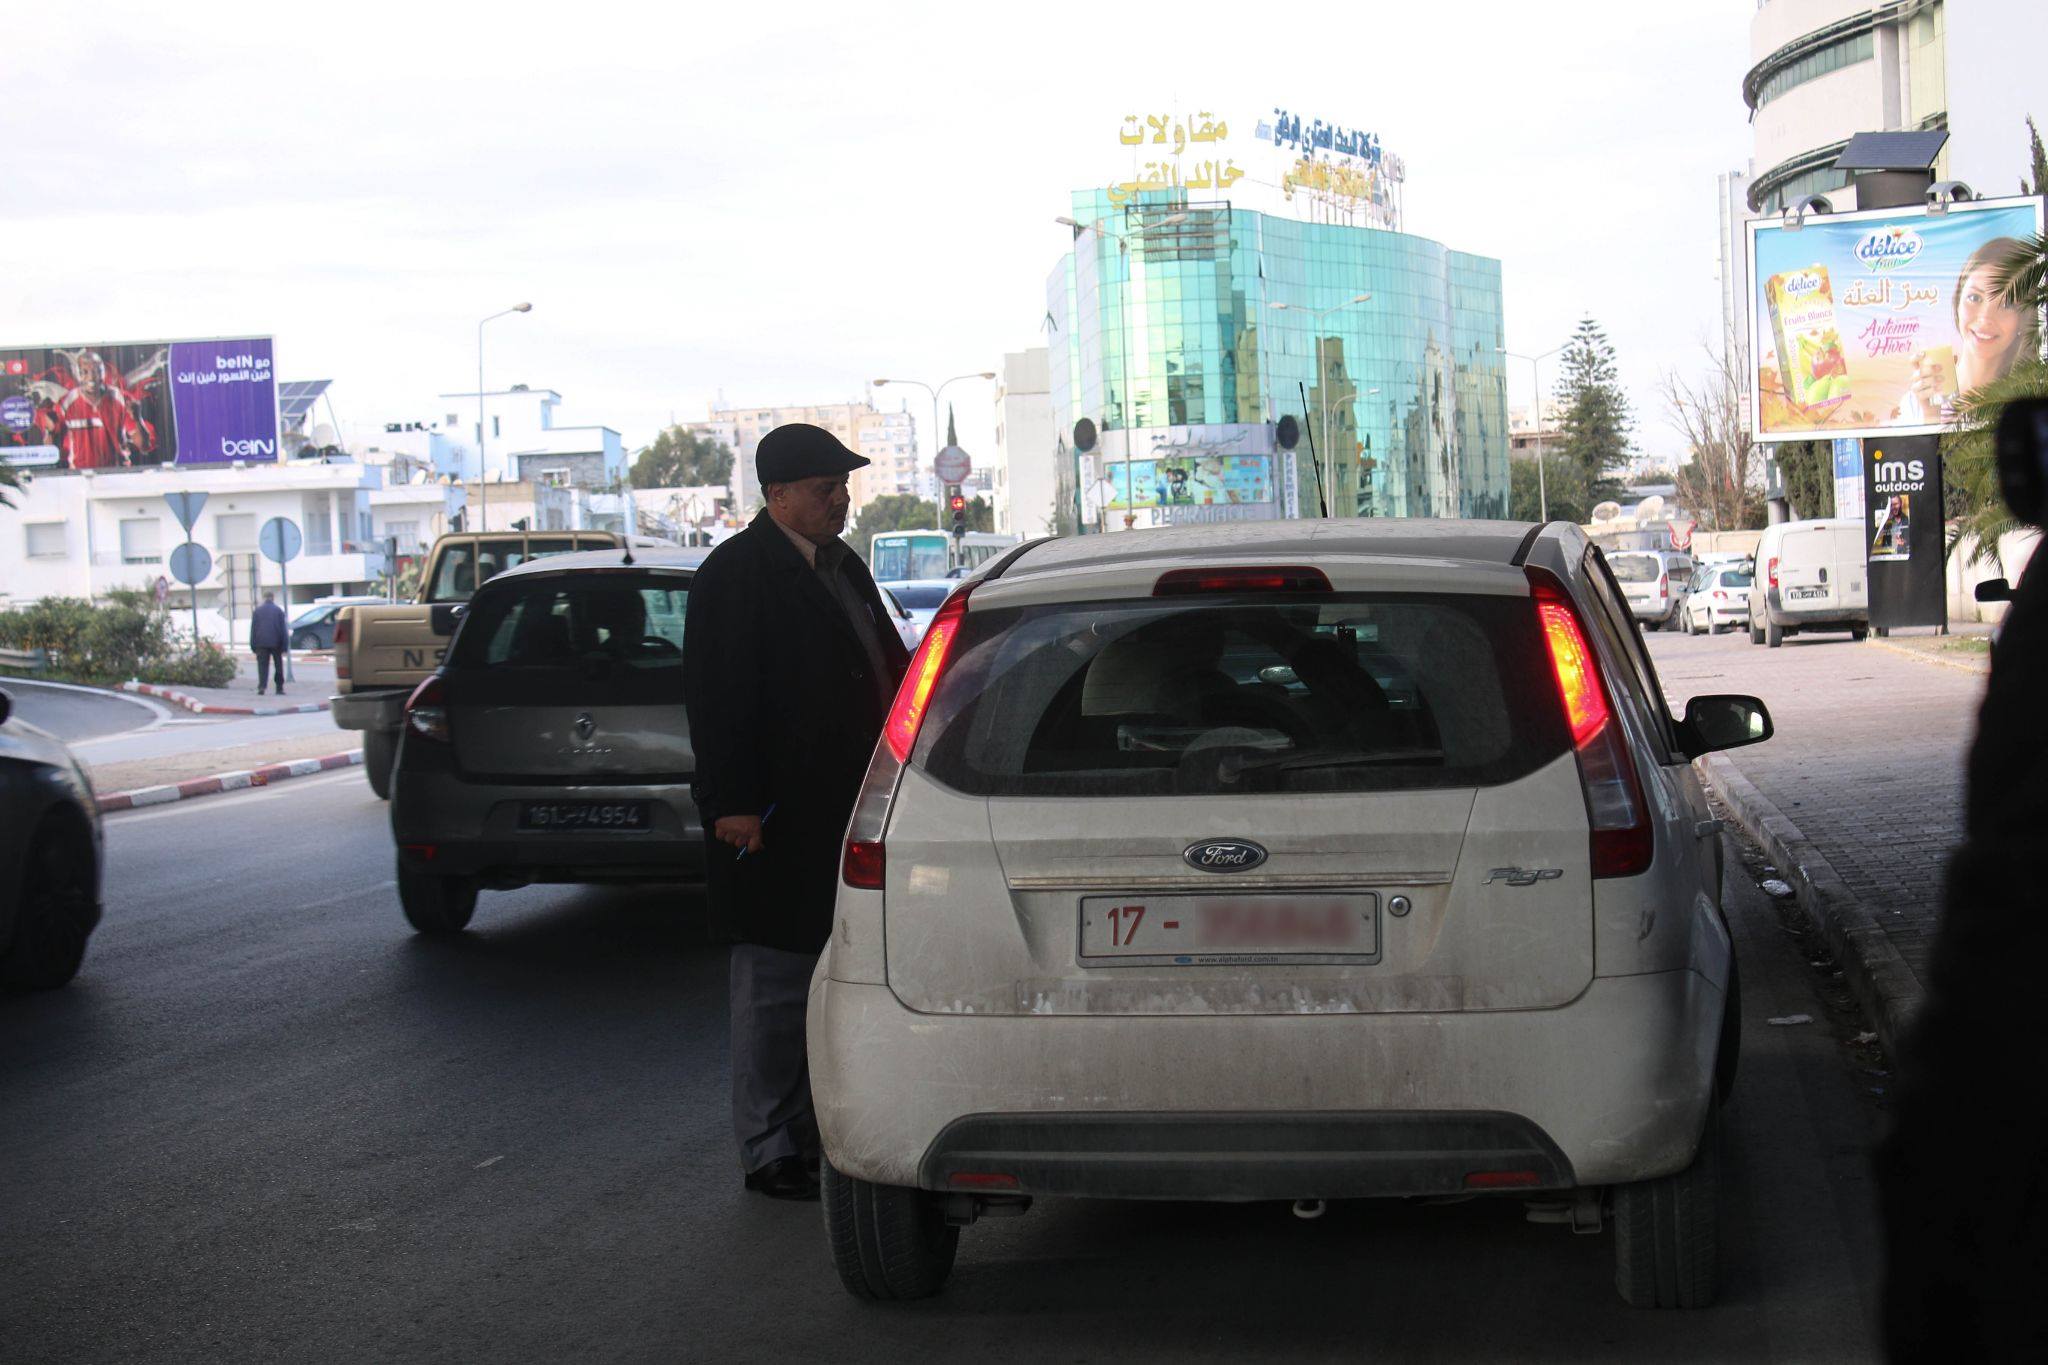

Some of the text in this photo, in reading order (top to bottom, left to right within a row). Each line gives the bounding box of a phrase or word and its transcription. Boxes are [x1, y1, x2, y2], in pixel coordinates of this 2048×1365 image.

[1120, 111, 1228, 155] مقاولات
[1184, 158, 1245, 189] خالد
[1860, 235, 1918, 259] délice
[1857, 316, 1920, 340] Automne
[1865, 337, 1913, 359] Hiver
[1874, 450, 1925, 483] ims
[1875, 482, 1925, 493] outdoor
[588, 806, 639, 824] 4954
[1202, 845, 1247, 866] Ford
[1481, 867, 1564, 887] Figo
[1107, 905, 1145, 947] 17
[1198, 954, 1278, 966] www.alphaford.com.tn
